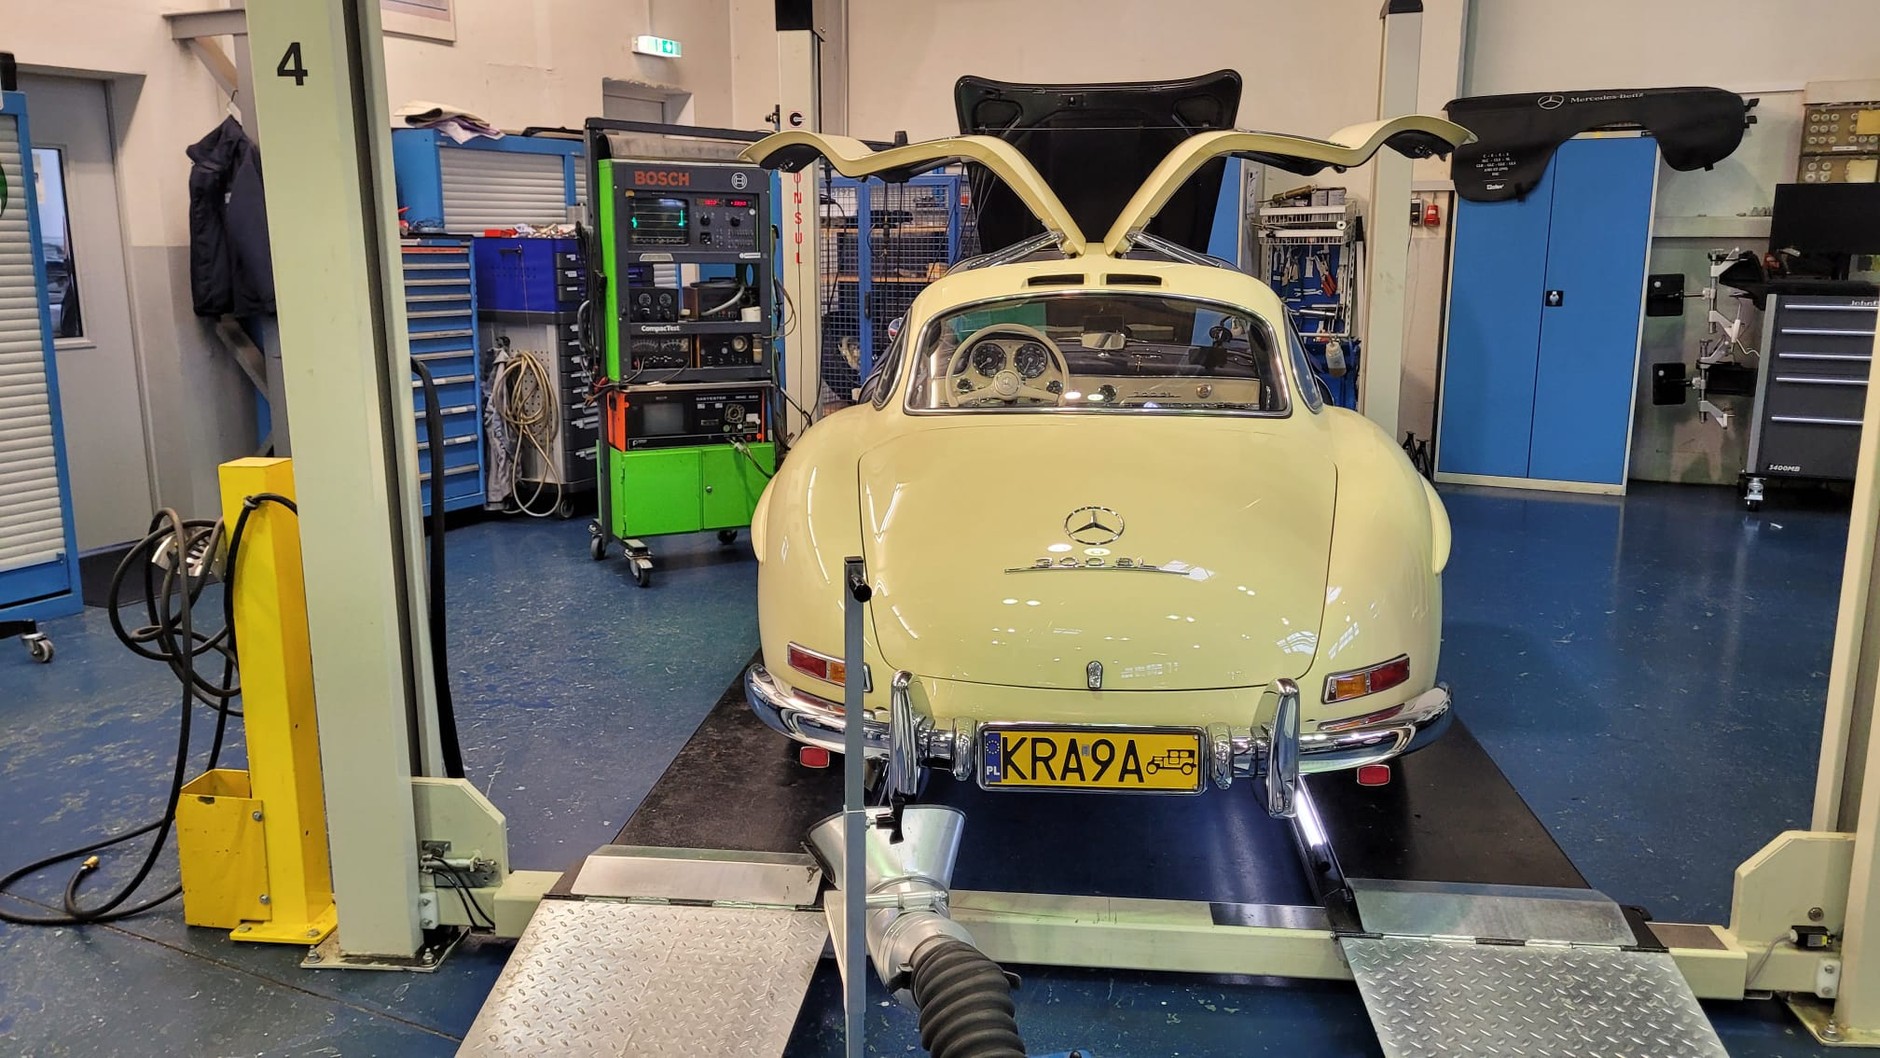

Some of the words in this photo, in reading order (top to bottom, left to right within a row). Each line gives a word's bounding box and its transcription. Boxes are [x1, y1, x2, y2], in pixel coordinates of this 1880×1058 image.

[277, 42, 308, 86] 4
[1570, 92, 1644, 104] Mercedes-Benz
[634, 171, 690, 186] BOSCH
[793, 172, 803, 265] ONSUL
[641, 325, 680, 333] CompacTest
[986, 765, 1000, 776] PL
